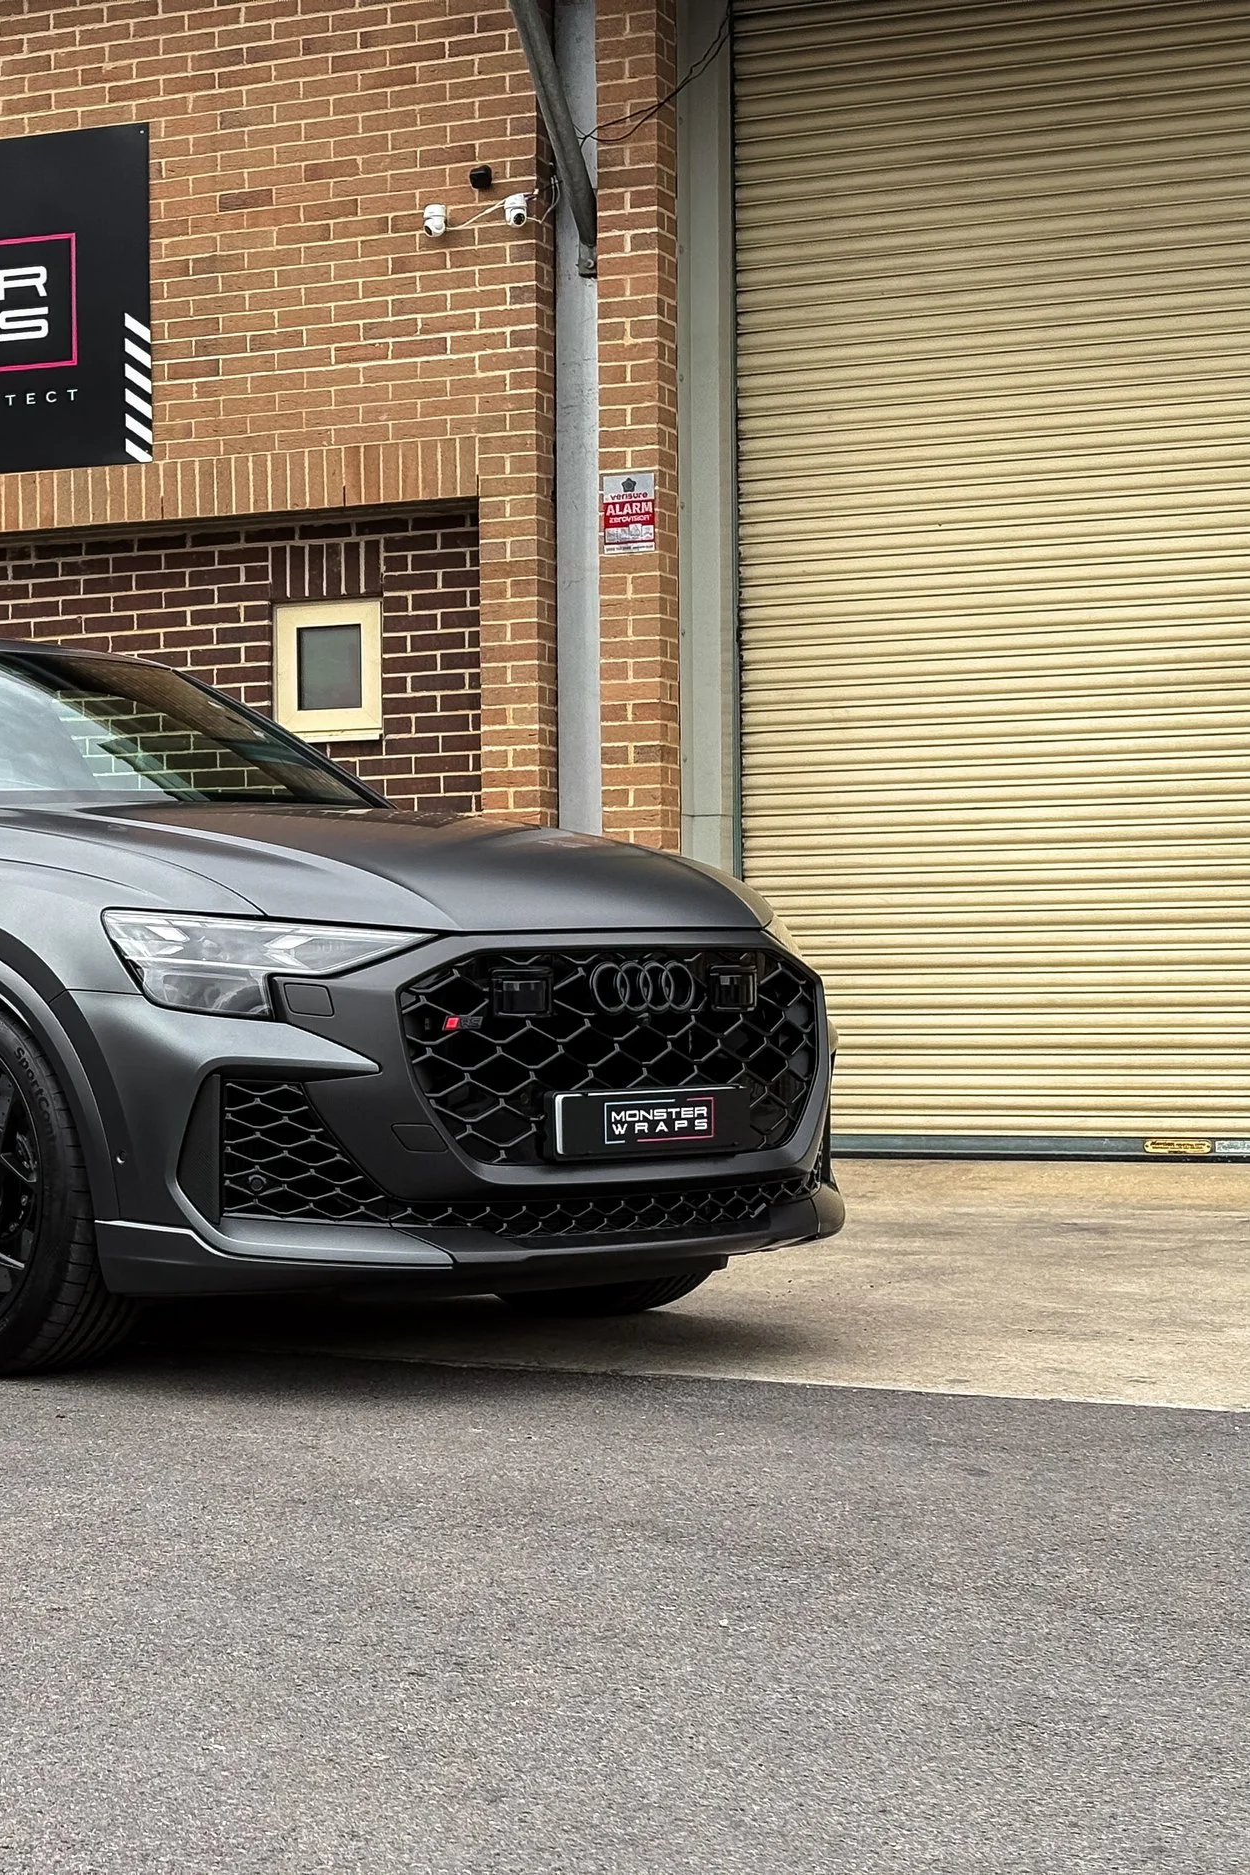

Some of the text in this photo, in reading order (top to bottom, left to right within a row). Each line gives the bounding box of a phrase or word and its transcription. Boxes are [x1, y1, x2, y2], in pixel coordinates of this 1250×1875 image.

[610, 491, 648, 500] verisure
[606, 501, 653, 516] ALARM
[611, 1106, 708, 1123] MONSTER
[611, 1118, 708, 1136] WRAPS
